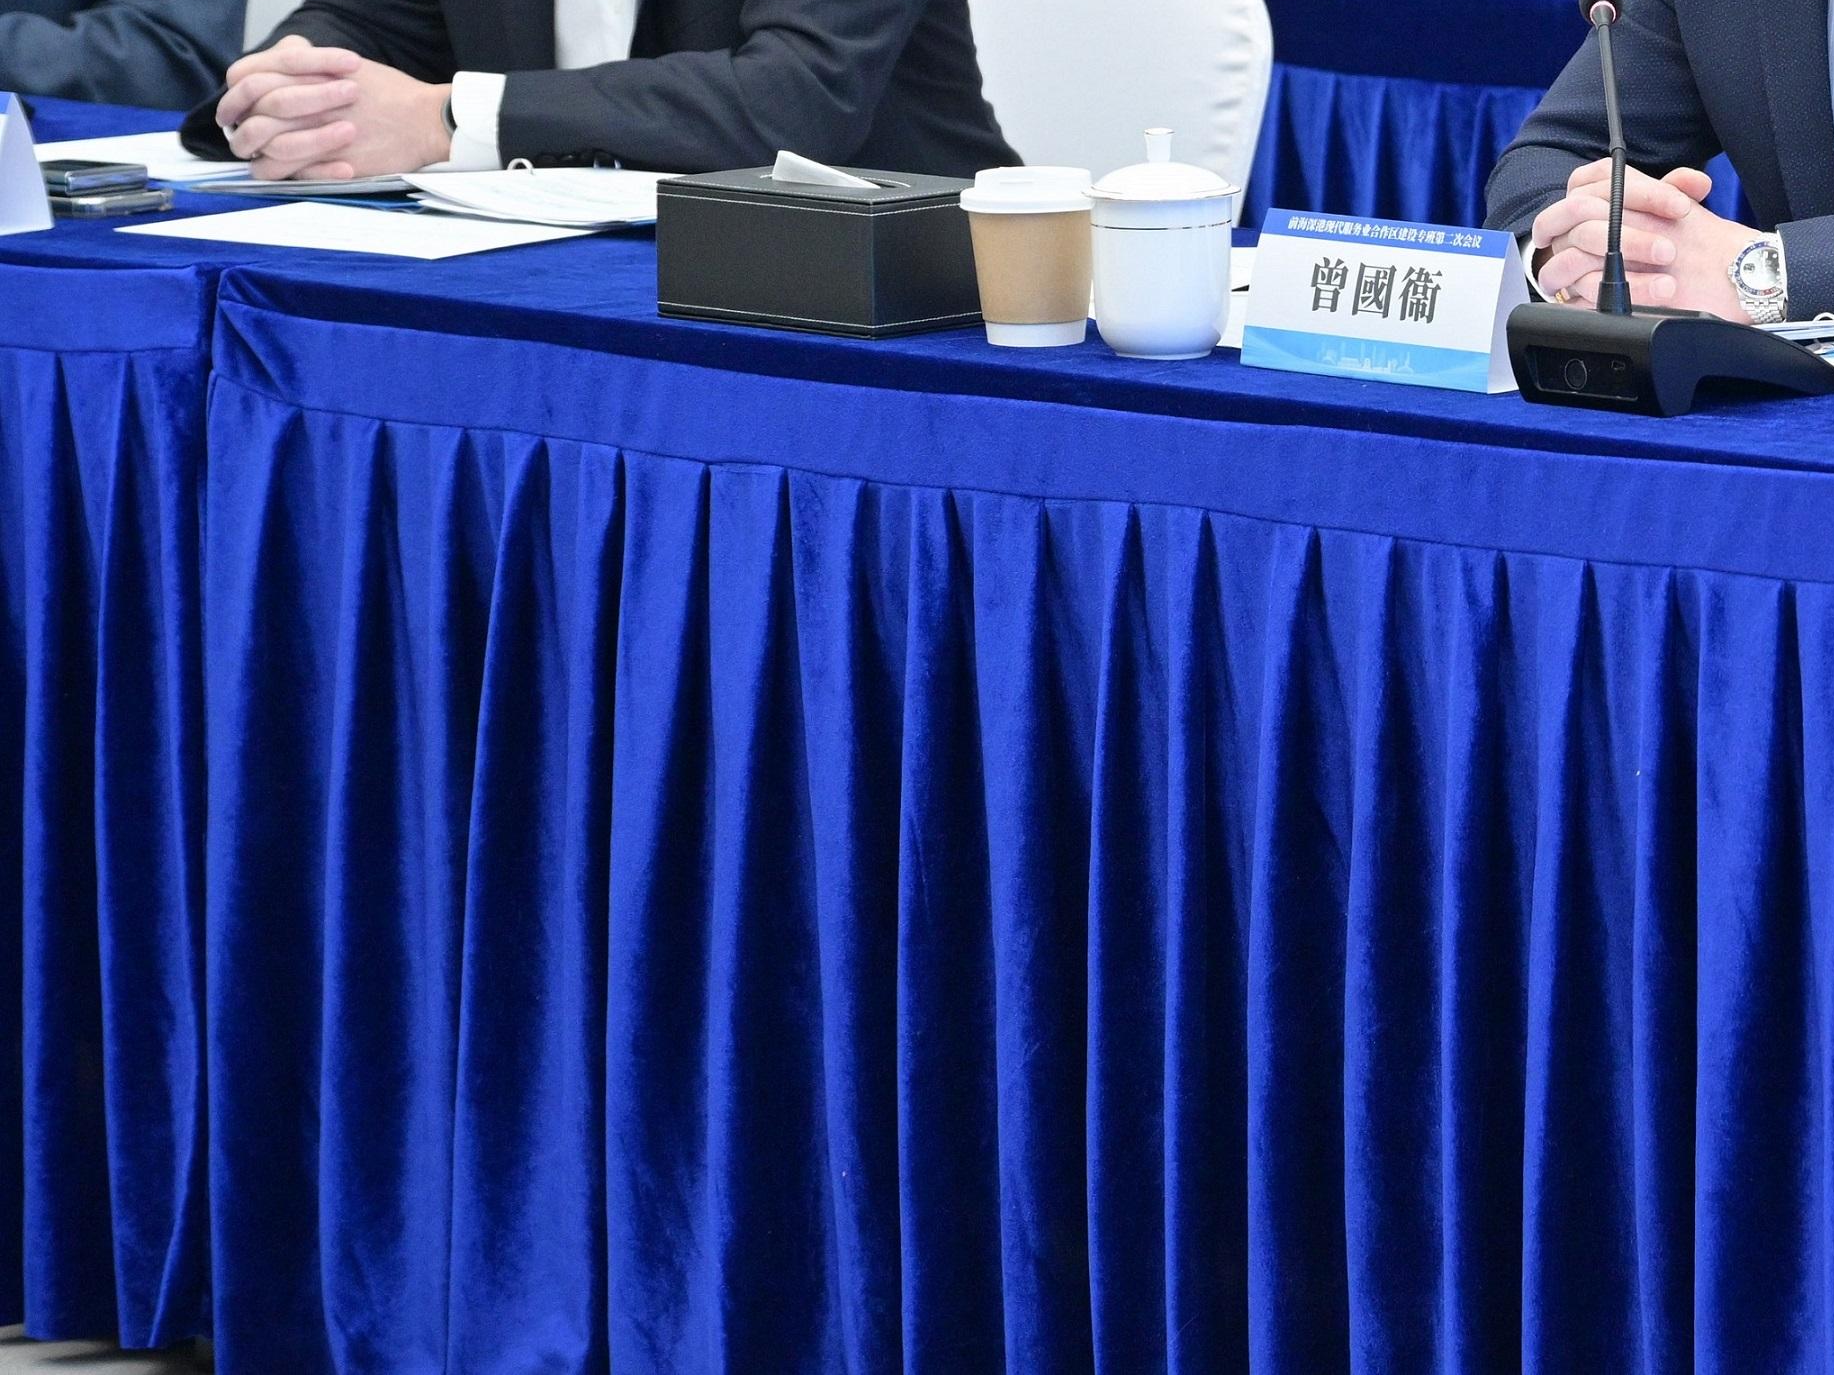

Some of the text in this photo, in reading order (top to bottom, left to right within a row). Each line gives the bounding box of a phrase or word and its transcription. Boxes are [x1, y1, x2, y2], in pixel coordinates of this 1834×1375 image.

[1287, 215, 1483, 249] 前海深港现代服务业合作区建设专班第二次会议
